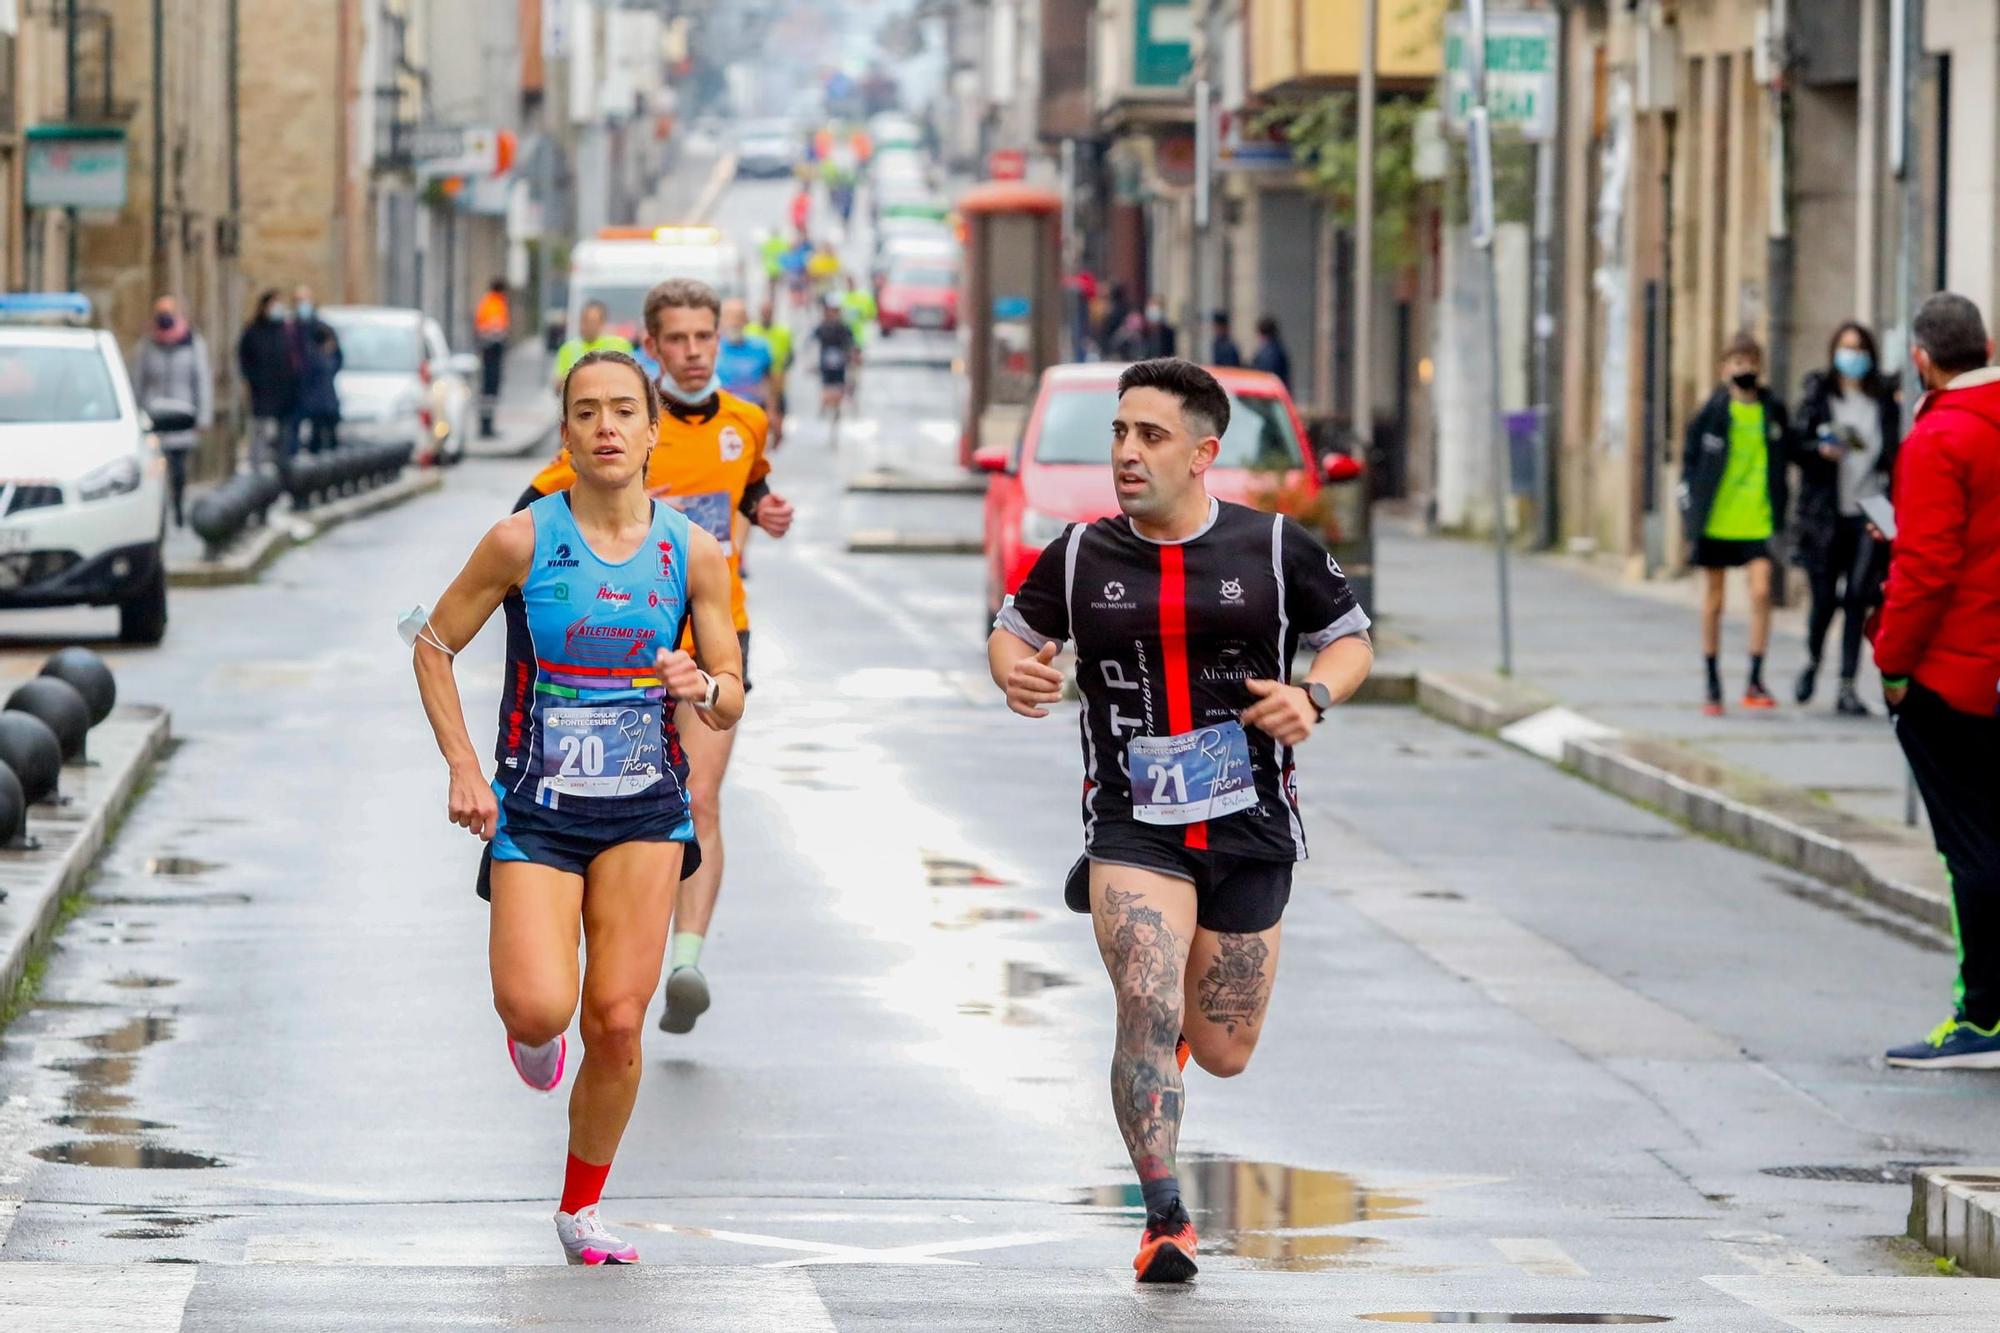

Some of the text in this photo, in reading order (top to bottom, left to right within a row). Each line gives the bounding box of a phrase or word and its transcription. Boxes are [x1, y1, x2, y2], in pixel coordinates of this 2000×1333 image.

[547, 559, 580, 568] VIATOR
[578, 625, 634, 638] ATLETISMO
[559, 735, 604, 776] 20
[1147, 763, 1188, 804] 21
